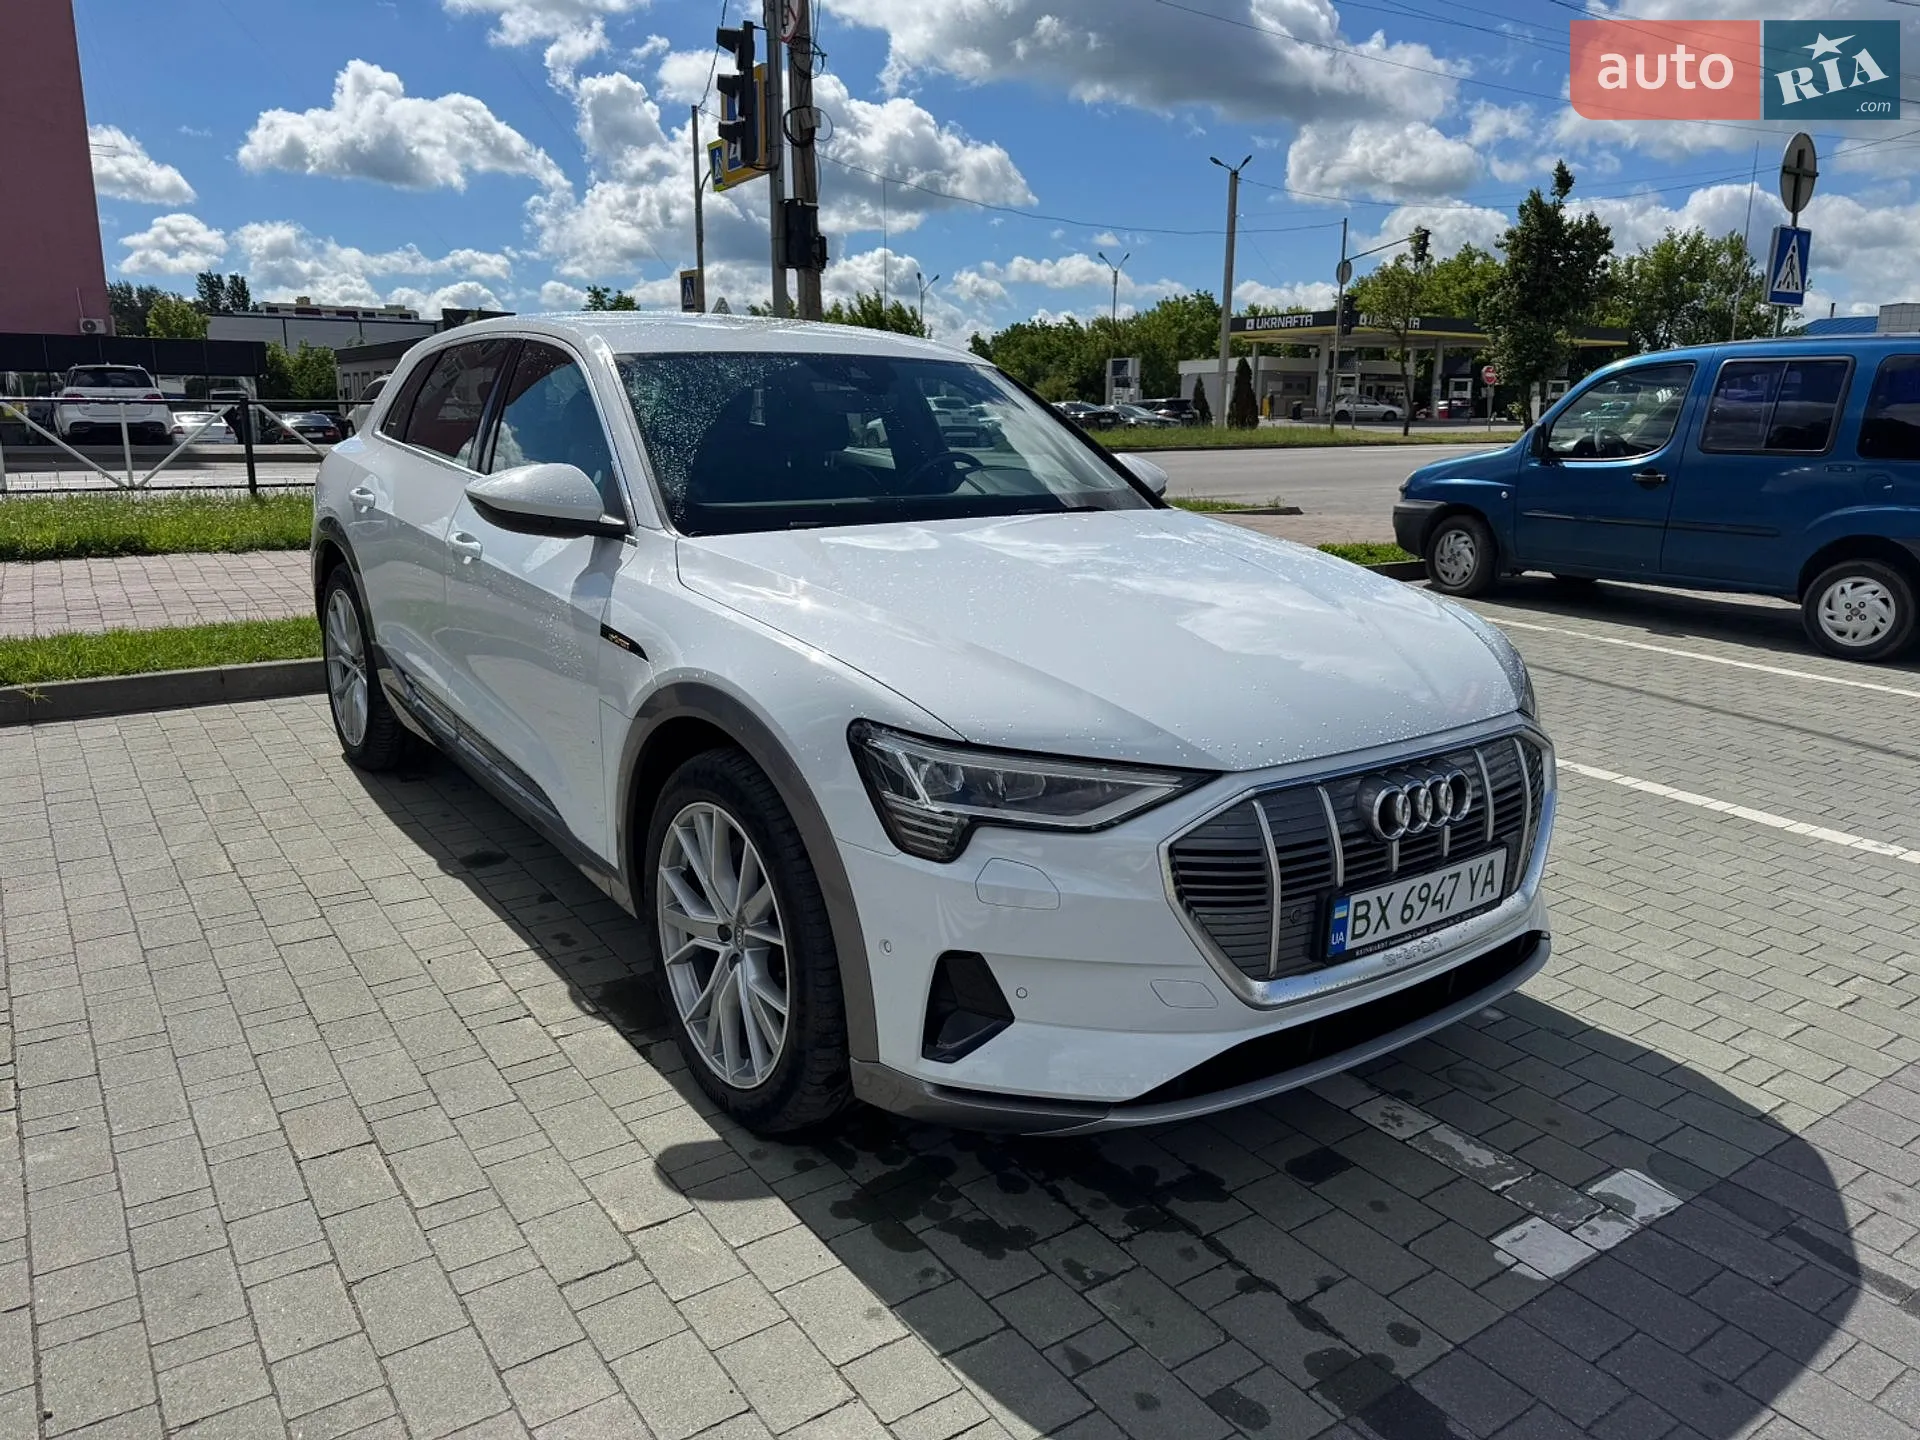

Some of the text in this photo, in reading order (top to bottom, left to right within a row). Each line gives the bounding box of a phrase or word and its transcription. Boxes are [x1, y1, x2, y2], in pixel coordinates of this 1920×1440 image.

[1256, 314, 1313, 329] UKRNAFTA
[1351, 892, 1394, 940] BX
[1400, 872, 1462, 925] 6947
[1468, 859, 1495, 902] YA
[1331, 931, 1345, 945] UA
